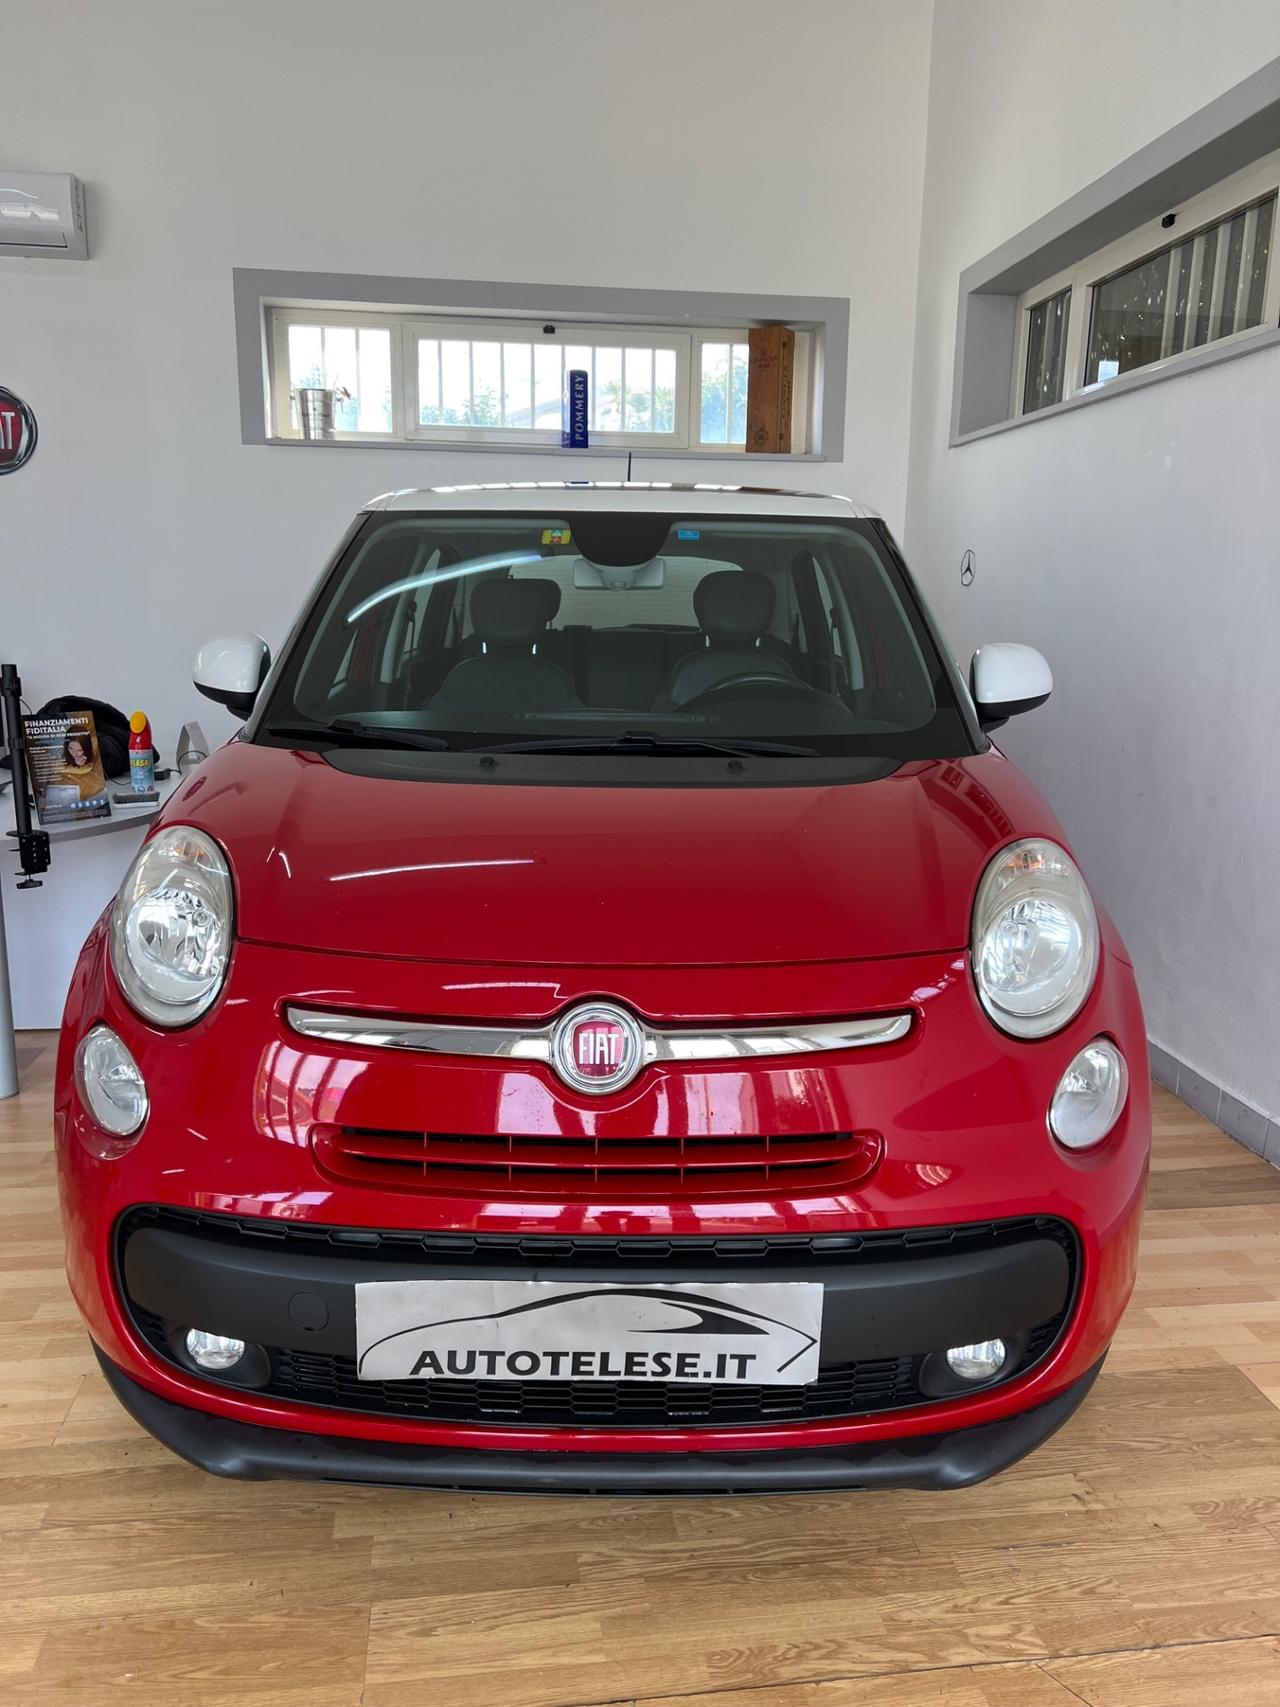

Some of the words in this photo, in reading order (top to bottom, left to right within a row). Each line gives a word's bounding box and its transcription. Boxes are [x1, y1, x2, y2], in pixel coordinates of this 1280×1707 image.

[575, 375, 584, 441] POMMERY
[25, 718, 88, 727] FINANZIAMENTI
[26, 726, 67, 735] FIDITALIA
[578, 1033, 619, 1065] FIAT
[409, 1350, 757, 1380] AUTOTELESE.IT
